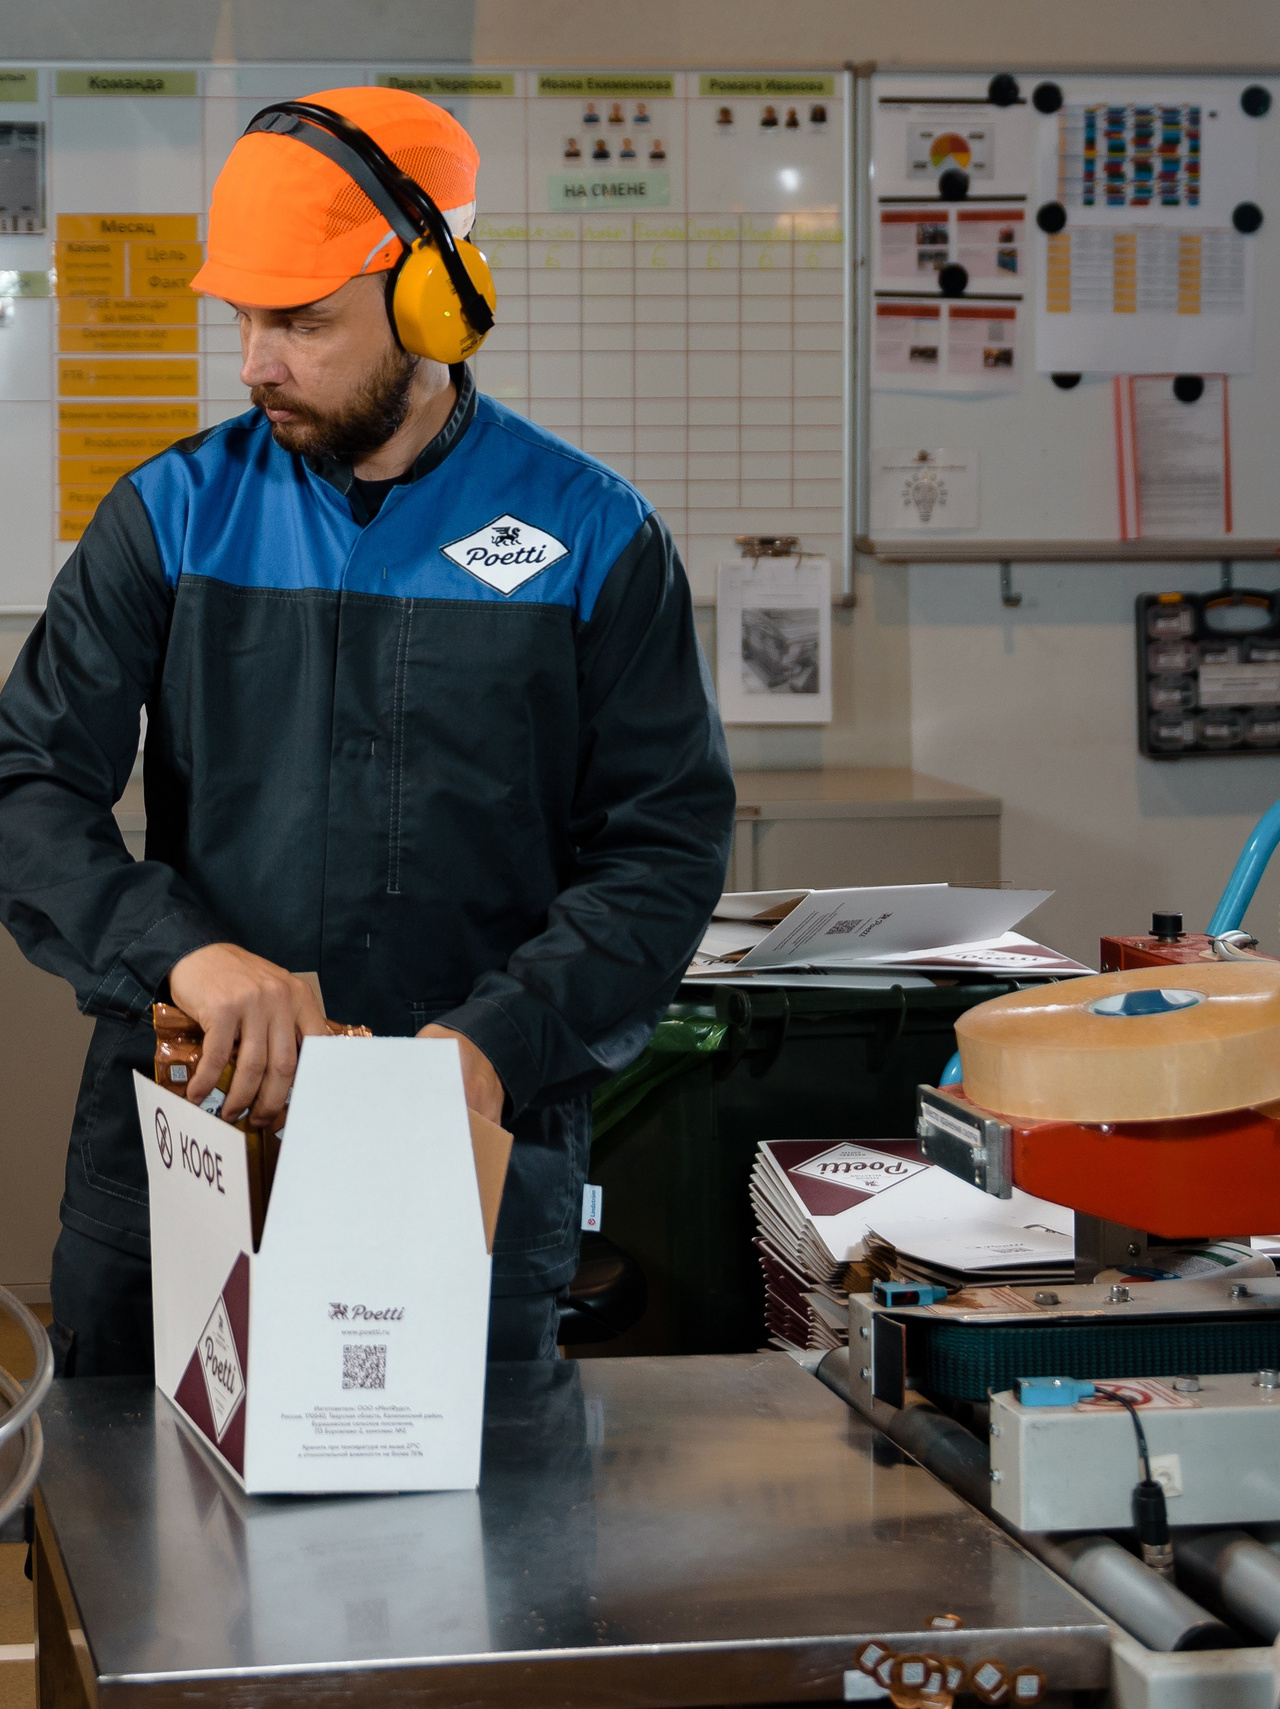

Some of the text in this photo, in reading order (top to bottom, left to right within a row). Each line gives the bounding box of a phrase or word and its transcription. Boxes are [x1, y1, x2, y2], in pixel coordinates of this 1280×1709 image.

[88, 75, 166, 91] Команда
[540, 77, 583, 90] Ивана
[710, 78, 824, 91] Романа Иванова
[564, 181, 647, 198] НА СМЕНЕ
[100, 219, 156, 236] Месяц
[145, 246, 186, 263] Цель
[148, 276, 187, 289] Факт
[85, 437, 147, 449] Production
[466, 544, 547, 567] Poetti
[180, 1130, 226, 1195] КОФЕ
[817, 1161, 909, 1176] Poetti
[351, 1304, 405, 1321] Poetti
[205, 1336, 235, 1395] Poetti
[280, 1412, 303, 1420] Россия,
[329, 1412, 356, 1420] Тверская
[357, 1411, 382, 1419] область,
[383, 1411, 422, 1419] Калининский
